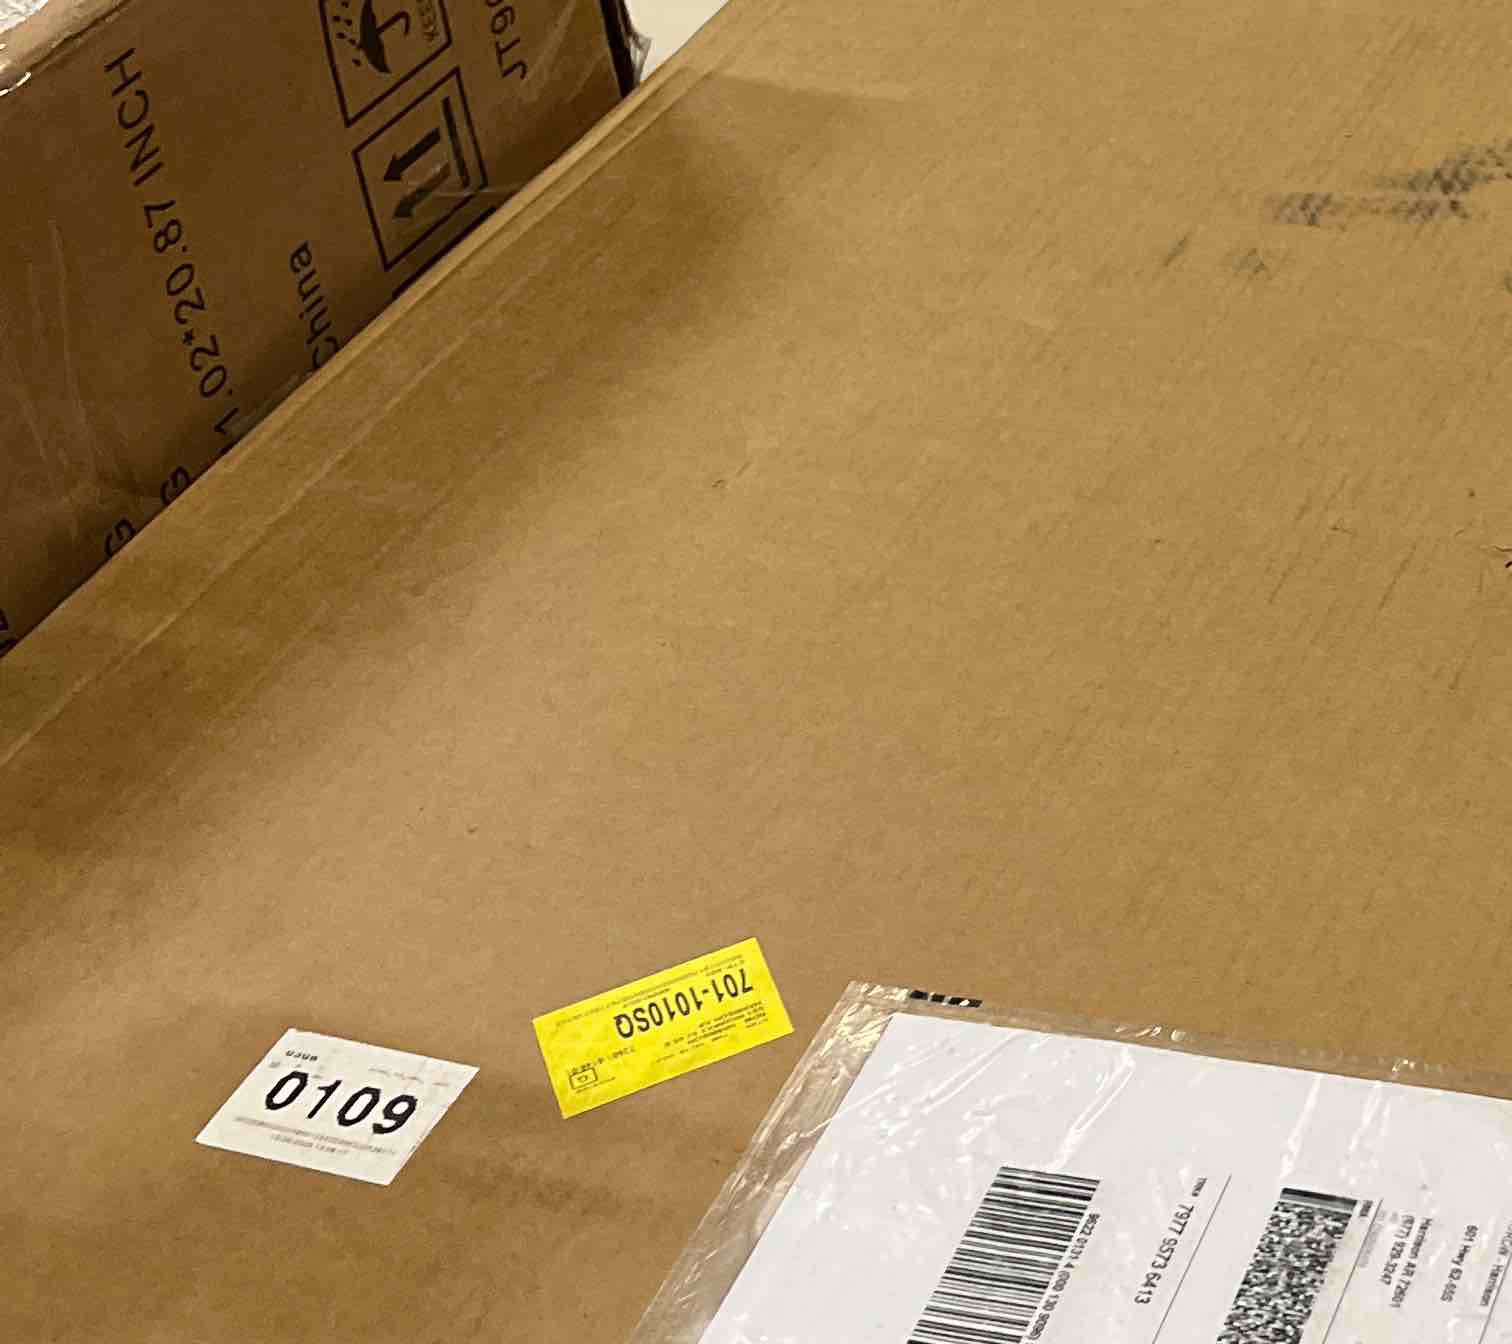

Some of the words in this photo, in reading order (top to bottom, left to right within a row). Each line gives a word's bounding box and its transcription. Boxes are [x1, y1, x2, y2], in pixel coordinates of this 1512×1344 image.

[104, 48, 164, 186] INCH
[614, 967, 753, 1040] 701-1010SQ
[265, 1070, 418, 1135] 0109
[1165, 1203, 1194, 1235] 7977
[1150, 1237, 1179, 1270] 9573
[1450, 1244, 1471, 1266] Hwy
[1132, 1271, 1162, 1305] 6413
